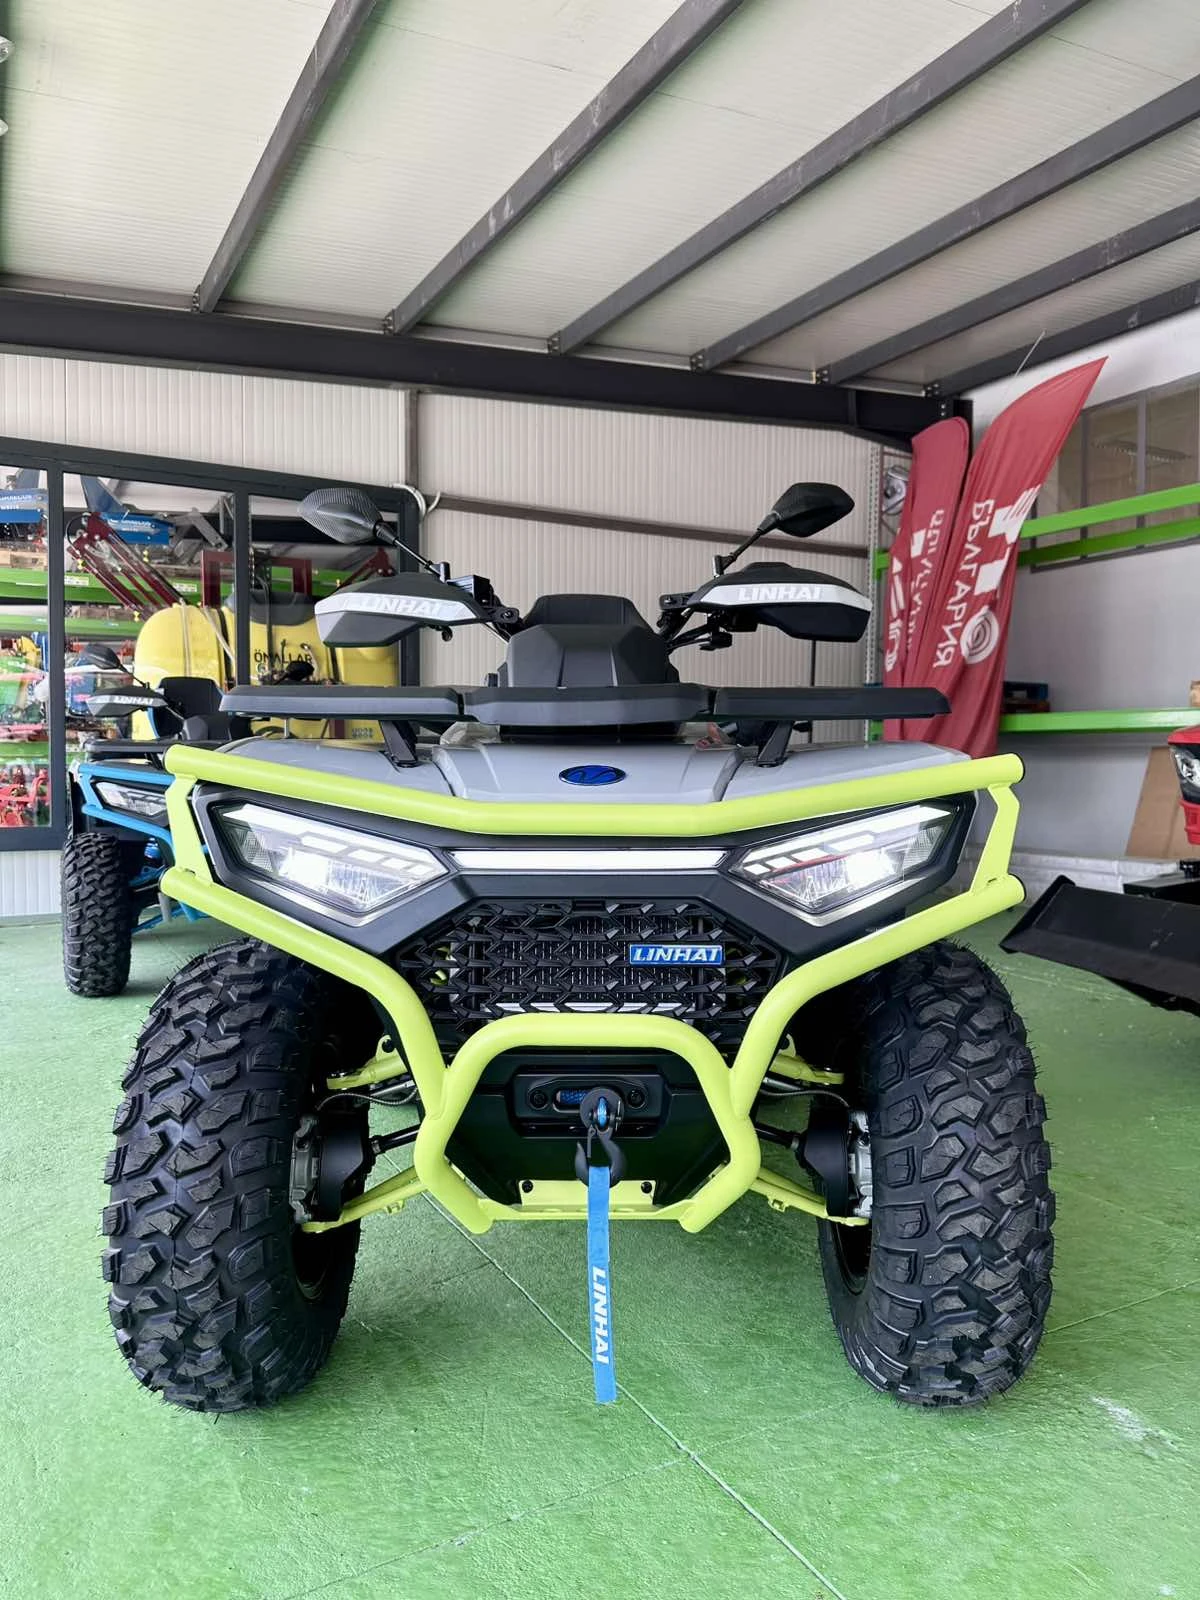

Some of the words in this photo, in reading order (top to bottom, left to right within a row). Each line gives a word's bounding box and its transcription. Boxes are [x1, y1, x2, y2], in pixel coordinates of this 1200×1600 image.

[932, 499, 995, 668] БЪЛГАРИЯ
[738, 586, 822, 601] LINHAI
[364, 598, 441, 617] LINHAI
[114, 696, 154, 706] LINHAI
[632, 947, 719, 962] LINHAI
[592, 1265, 610, 1365] LINHAI
